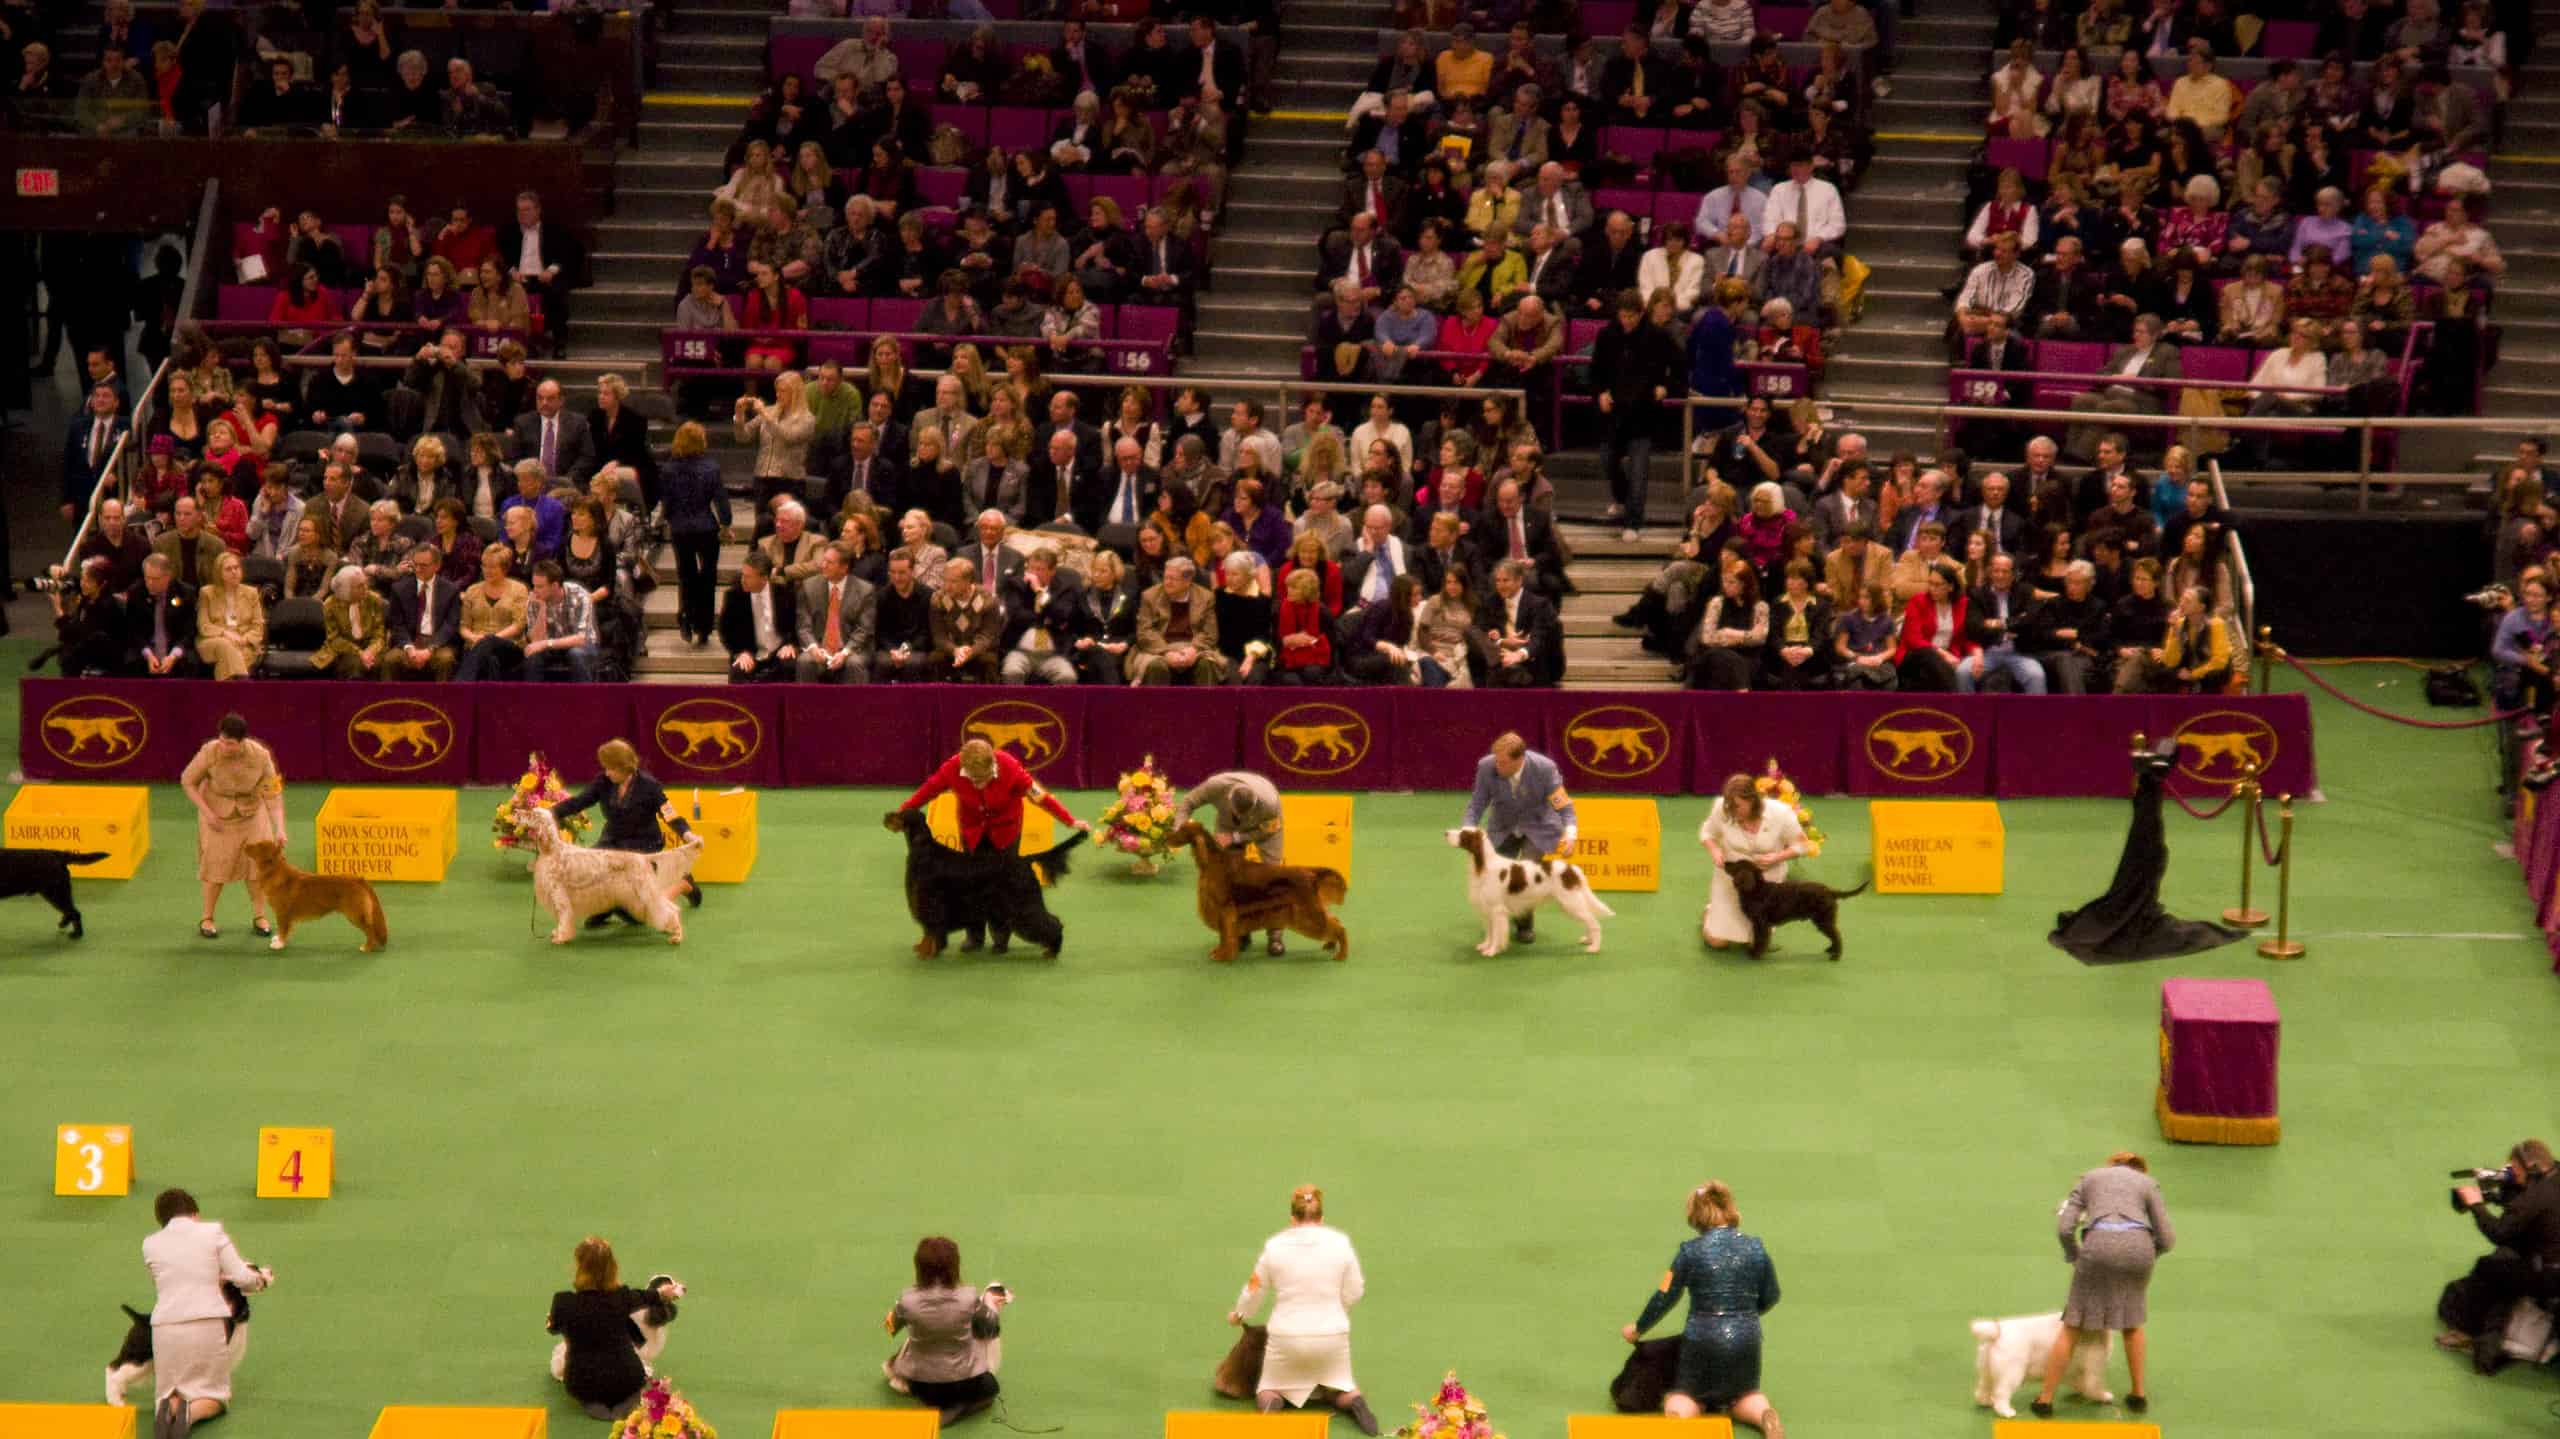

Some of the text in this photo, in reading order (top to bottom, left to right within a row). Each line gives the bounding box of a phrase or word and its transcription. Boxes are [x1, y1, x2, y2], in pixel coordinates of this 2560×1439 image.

[23, 171, 52, 193] EXIT
[684, 341, 706, 359] 55
[1127, 352, 1150, 370] 56
[1767, 375, 1792, 393] 58
[1973, 381, 1998, 400] 59
[10, 825, 80, 841] LABRADOR
[322, 826, 358, 839] NOVA
[361, 826, 408, 839] SCOTIA
[323, 843, 419, 857] DUCK TOLLING
[1886, 839, 1953, 852] AMERICAN
[323, 860, 392, 874] RETRIEVER
[1616, 864, 1651, 877] WHITE
[1884, 856, 1928, 870] WATER
[1883, 873, 1935, 887] SPANIEL
[77, 1143, 104, 1191] 3
[278, 1150, 304, 1192] 4
